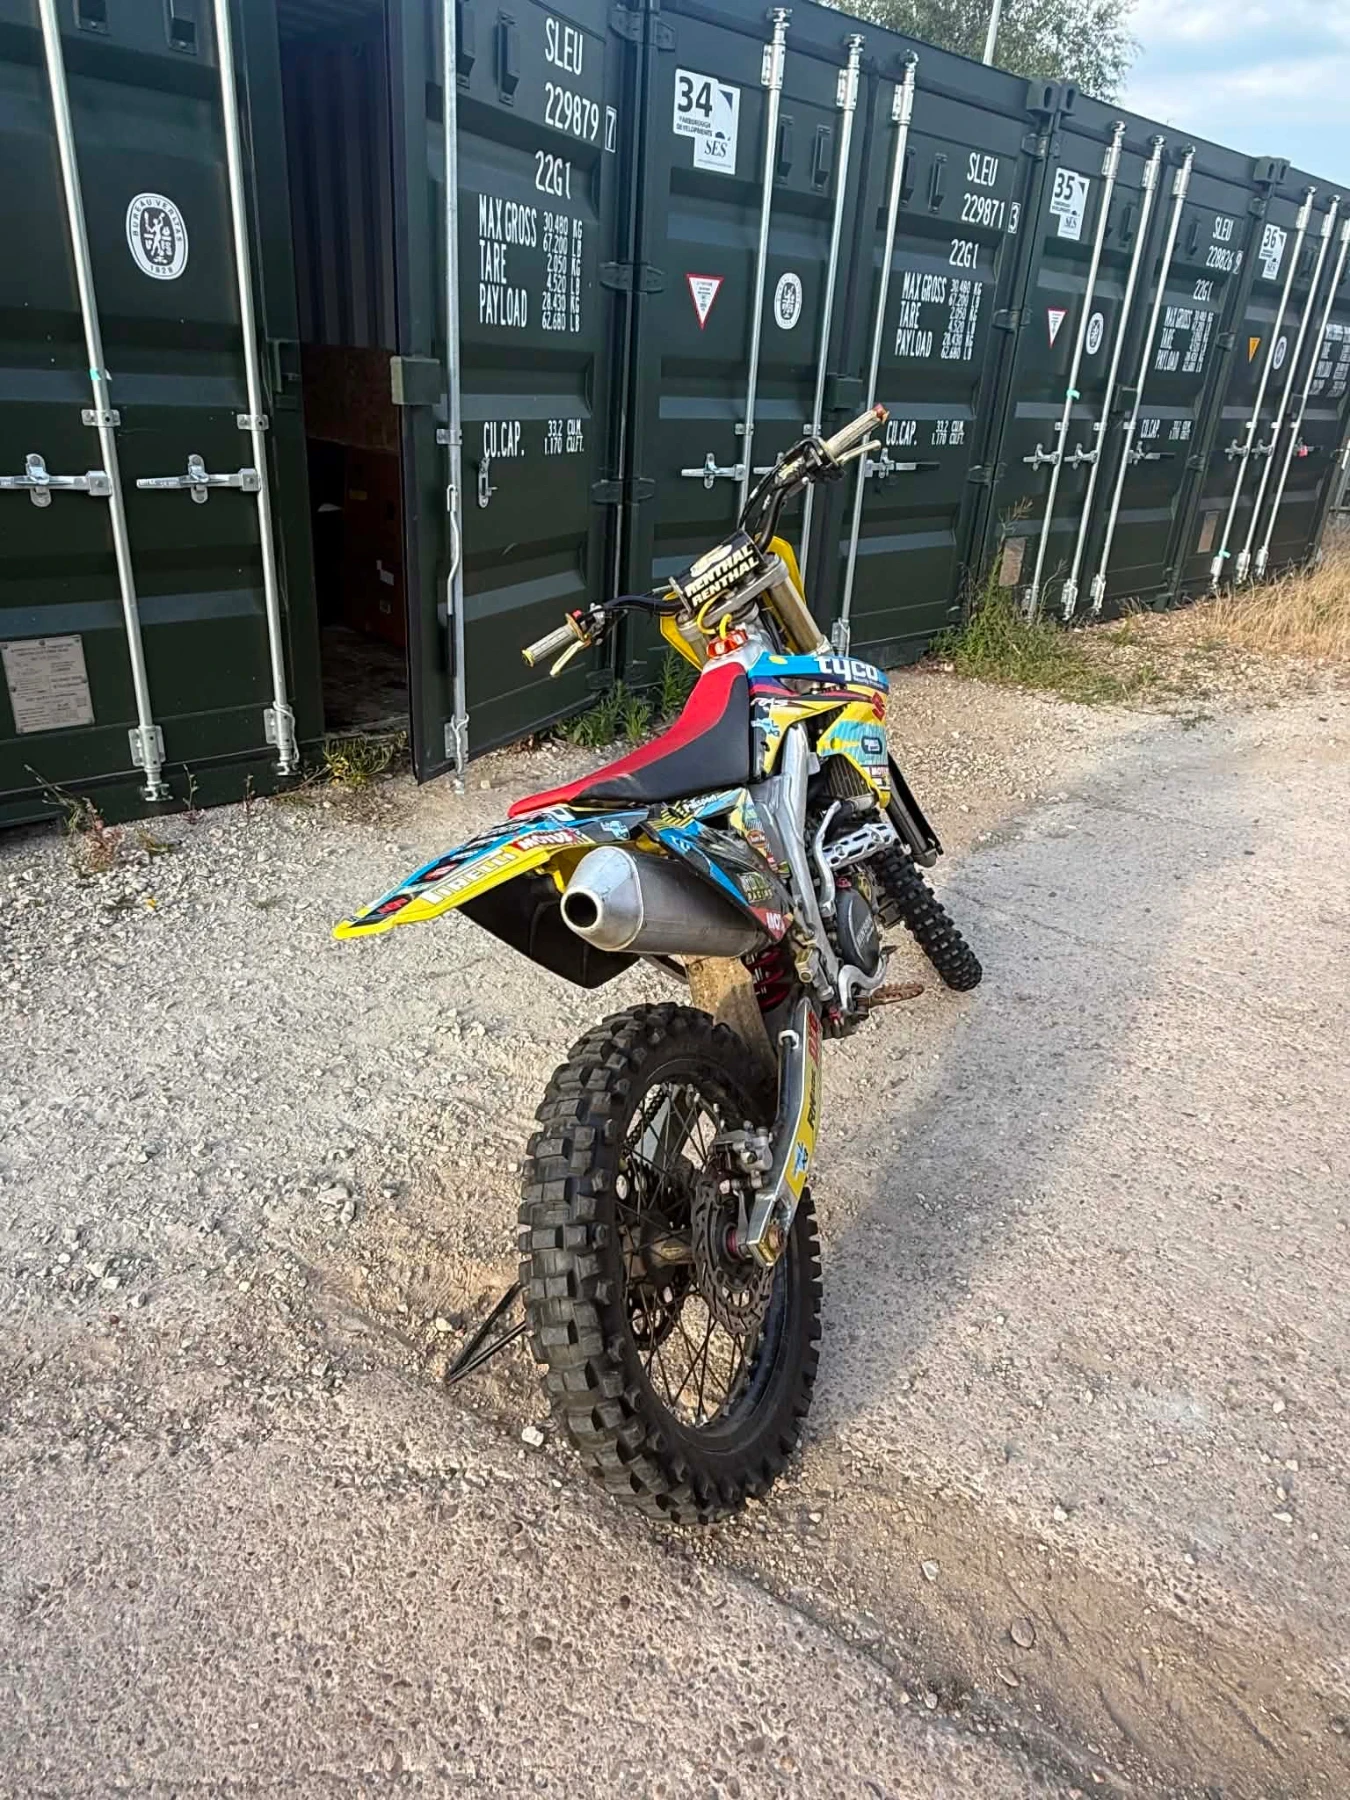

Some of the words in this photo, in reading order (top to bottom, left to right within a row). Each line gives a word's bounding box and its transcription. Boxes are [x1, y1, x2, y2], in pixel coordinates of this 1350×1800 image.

[545, 17, 583, 75] SLEU
[677, 75, 713, 117] 34
[545, 82, 599, 141] 229879
[606, 109, 616, 150] 7
[704, 140, 728, 158] SES
[535, 150, 571, 200] 22G1
[966, 152, 998, 187] SLEU
[1055, 172, 1075, 200] 35
[133, 199, 152, 237] BUREAU
[479, 193, 502, 240] MAX
[505, 201, 537, 247] GROSS
[543, 211, 569, 236] 30.480
[573, 219, 582, 239] KG
[961, 193, 1005, 229] 229871
[1008, 204, 1020, 232] 3
[1212, 216, 1234, 241] SLEU
[572, 239, 581, 258] LB
[949, 239, 979, 270] 22G1
[1264, 227, 1278, 248] 36
[479, 239, 507, 284] TARE
[571, 257, 580, 276] KG
[571, 276, 580, 296] LB
[902, 271, 921, 300] MAX
[921, 273, 947, 304] GROSS
[479, 283, 528, 327] PAYLOAD
[570, 294, 579, 313] KG
[570, 313, 579, 332] LB
[900, 300, 921, 329] TARE
[895, 328, 933, 358] PAYLOAD
[483, 421, 525, 458] CU.CAP.
[548, 420, 562, 437] 33.2
[886, 420, 917, 446] CU.CAP.
[684, 542, 754, 598] RENTHAL
[691, 556, 760, 607] RENTHAL
[814, 657, 879, 681] tyco
[421, 848, 520, 905] PIRELLI
